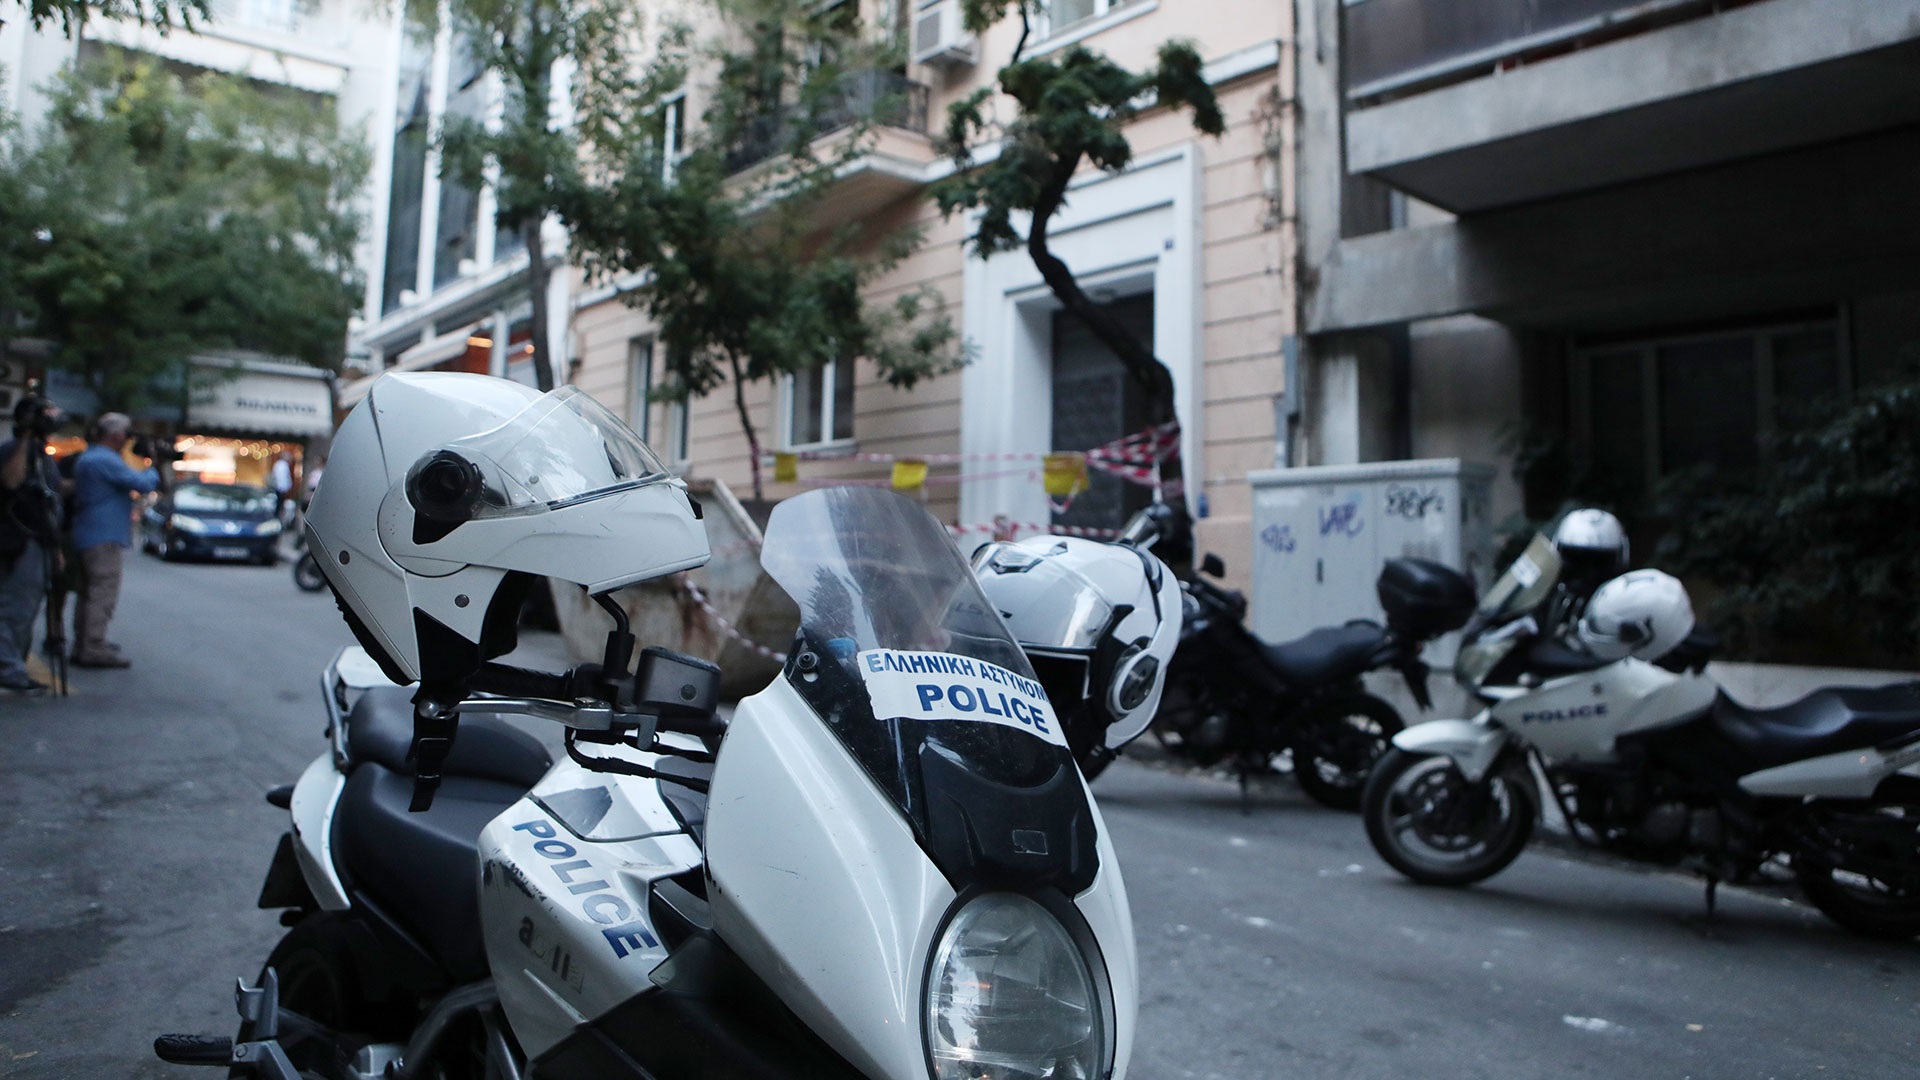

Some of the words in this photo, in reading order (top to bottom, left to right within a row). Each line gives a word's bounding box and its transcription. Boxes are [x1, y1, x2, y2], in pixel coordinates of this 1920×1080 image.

[866, 652, 976, 677] ΕΛΛΗΝΙΚΗ
[916, 684, 1050, 734] POLICE
[1521, 702, 1607, 723] POLICE
[512, 819, 659, 959] POLICE
